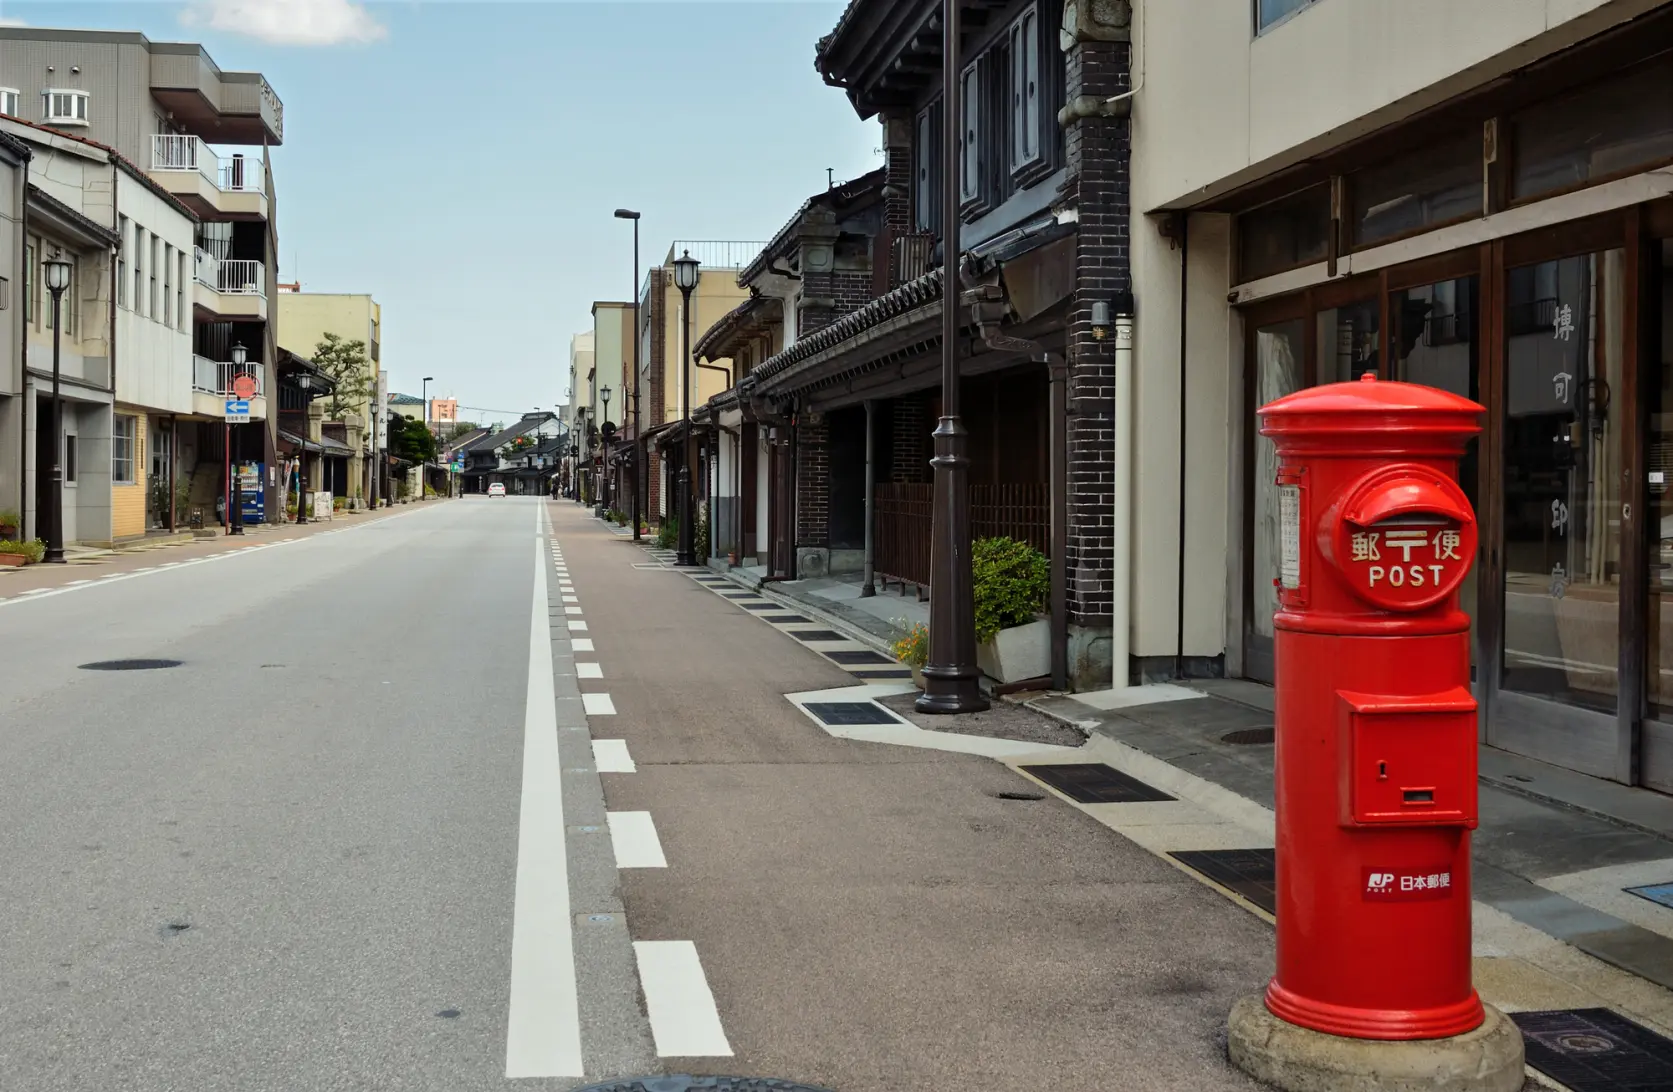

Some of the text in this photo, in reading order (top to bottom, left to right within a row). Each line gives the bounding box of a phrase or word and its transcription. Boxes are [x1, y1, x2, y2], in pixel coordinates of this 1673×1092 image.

[1369, 565, 1444, 587] POST
[1368, 873, 1394, 887] JP
[1401, 873, 1450, 890] 日本郵便
